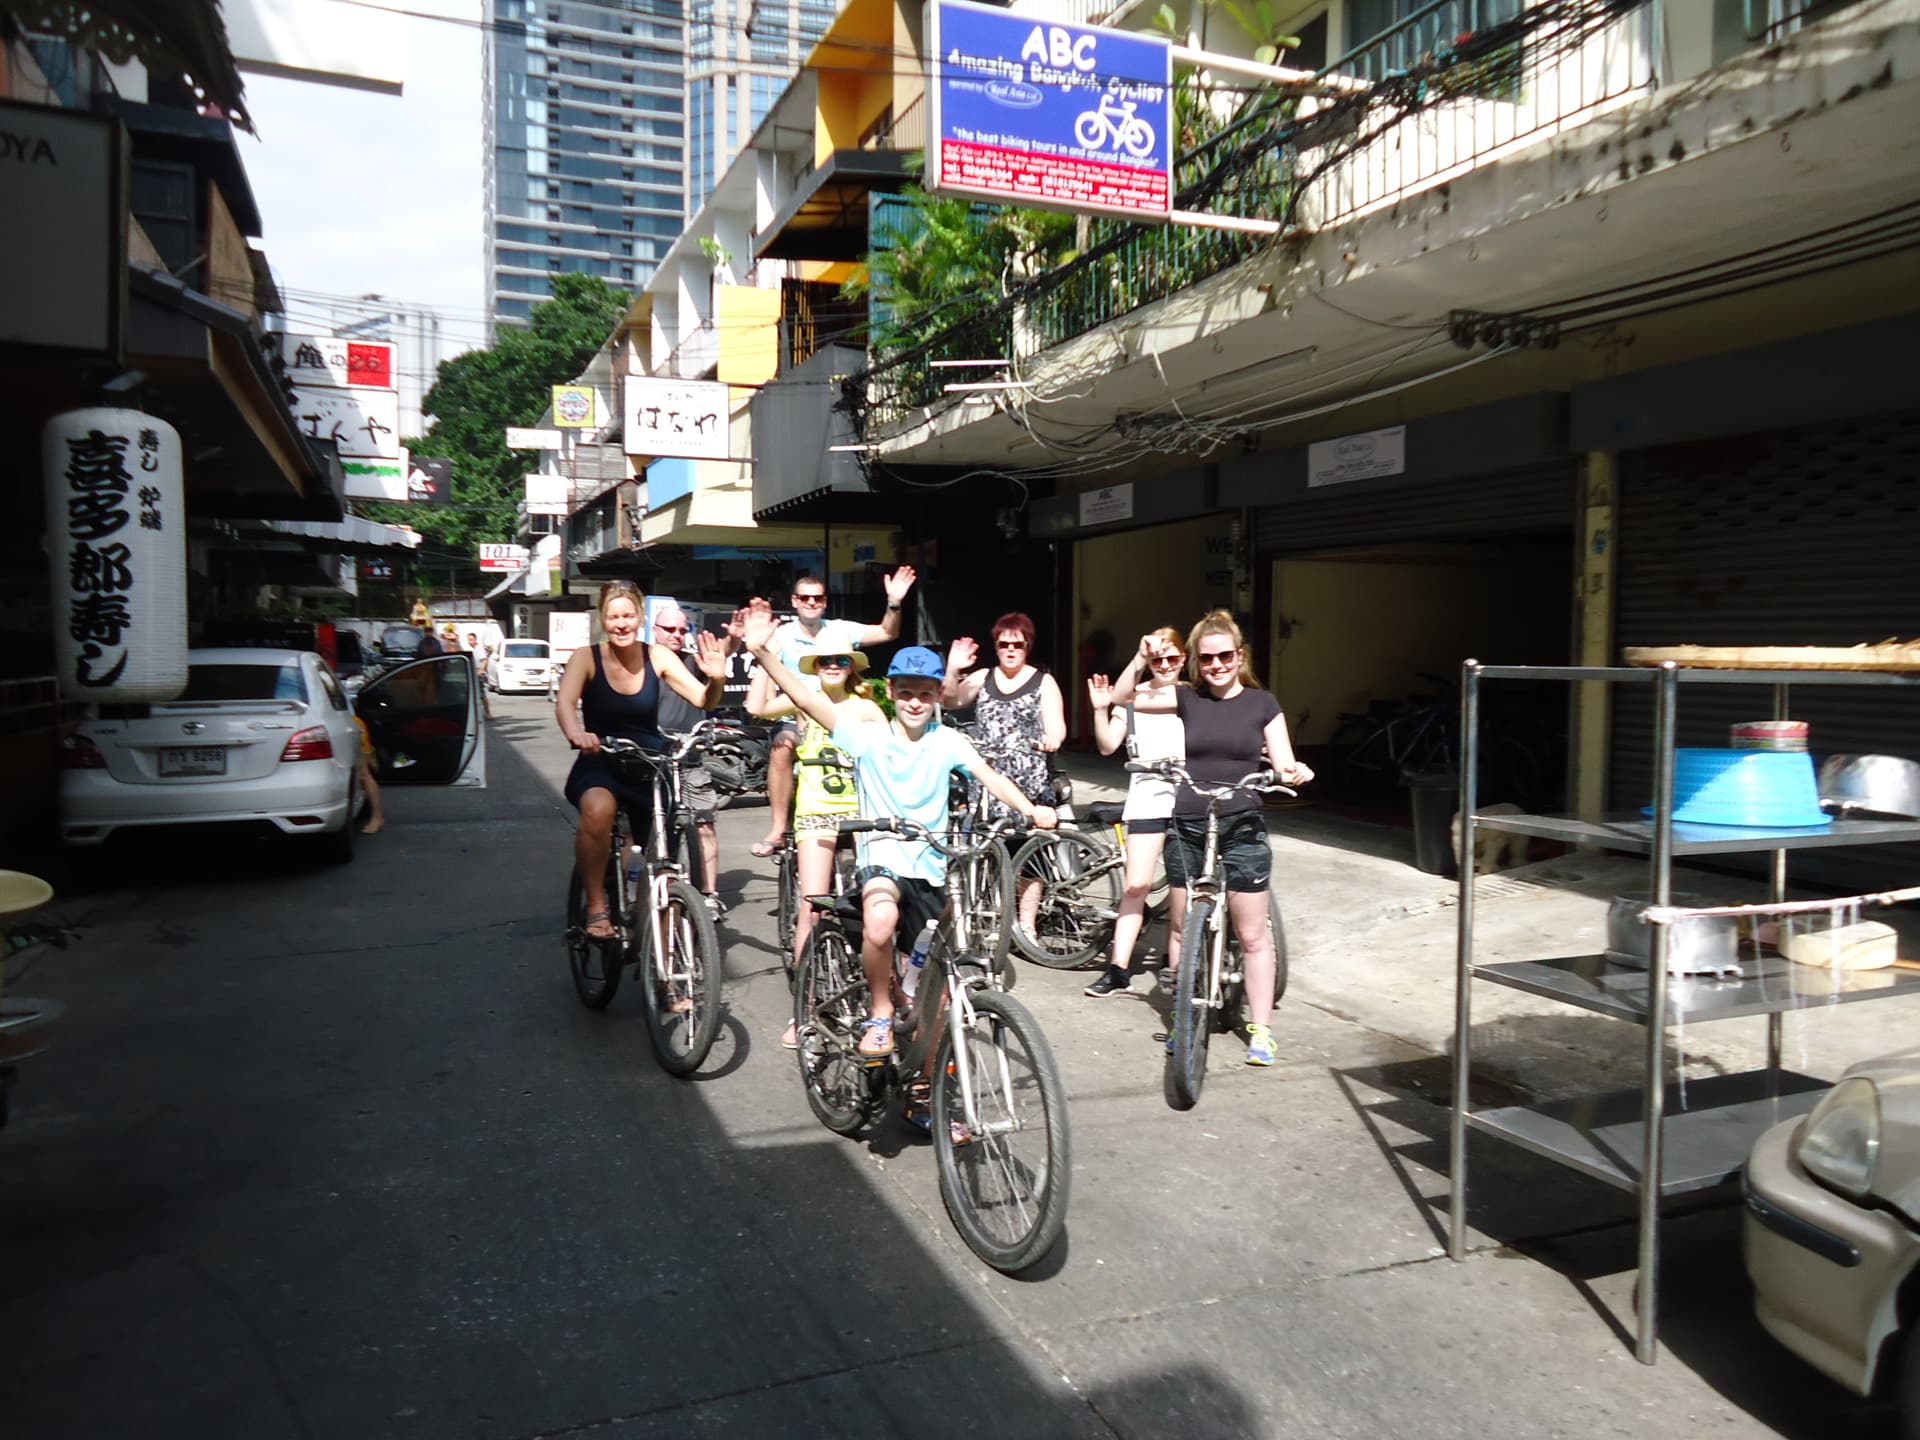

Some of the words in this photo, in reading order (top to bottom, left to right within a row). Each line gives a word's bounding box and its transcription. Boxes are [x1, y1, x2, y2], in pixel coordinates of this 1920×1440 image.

[1021, 26, 1097, 71] ABC
[948, 48, 1024, 84] Amazing
[1108, 76, 1164, 104] Cyclist
[976, 130, 998, 145] best
[1001, 134, 1029, 153] biking
[1032, 139, 1057, 154] tours
[1058, 144, 1068, 156] in
[1069, 147, 1085, 158] and
[1086, 149, 1118, 164] around
